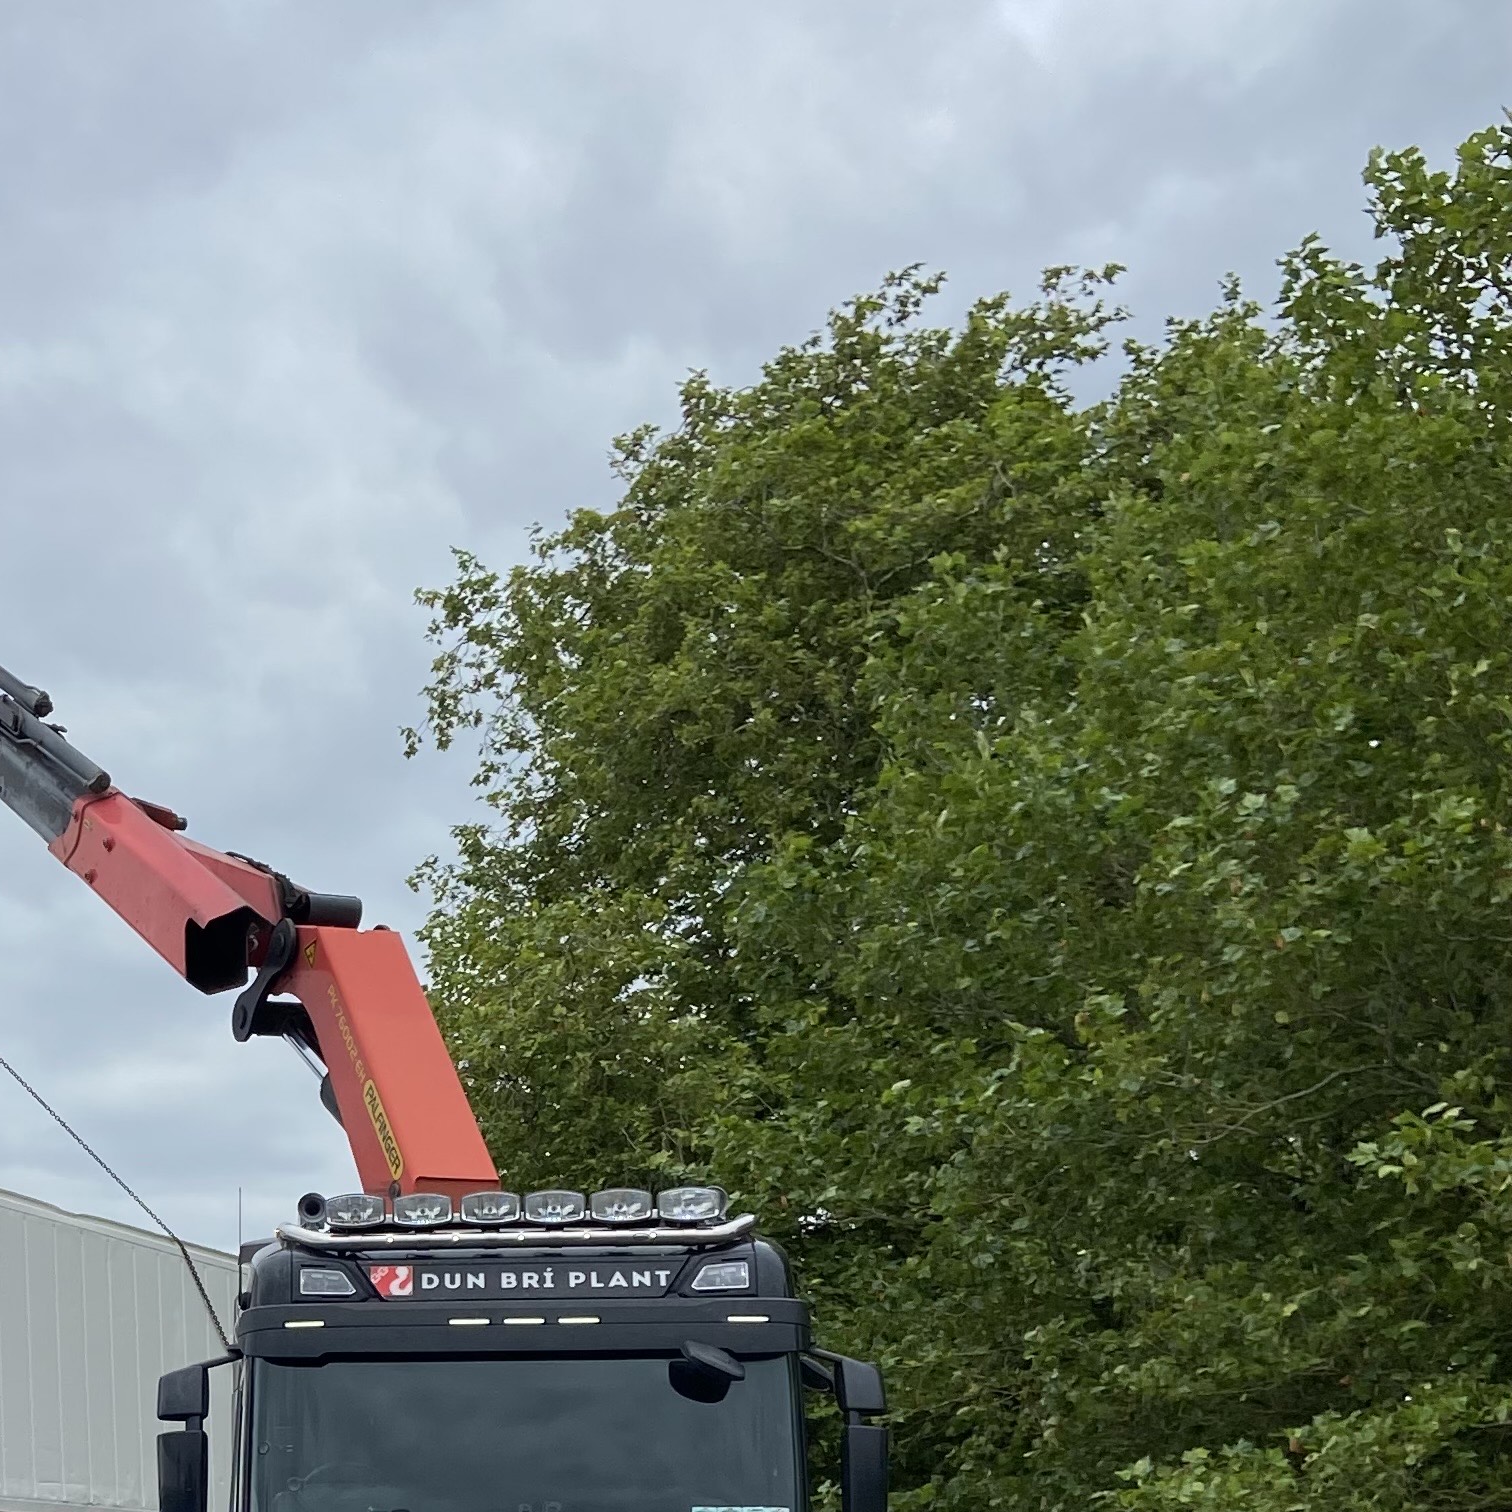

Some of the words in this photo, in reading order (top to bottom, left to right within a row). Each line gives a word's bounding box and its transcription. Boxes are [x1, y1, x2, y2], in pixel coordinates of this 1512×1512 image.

[365, 1084, 402, 1175] PALFINGER
[421, 1272, 486, 1290] DUN
[500, 1267, 555, 1289] BRÍ
[568, 1270, 671, 1288] PLANT
